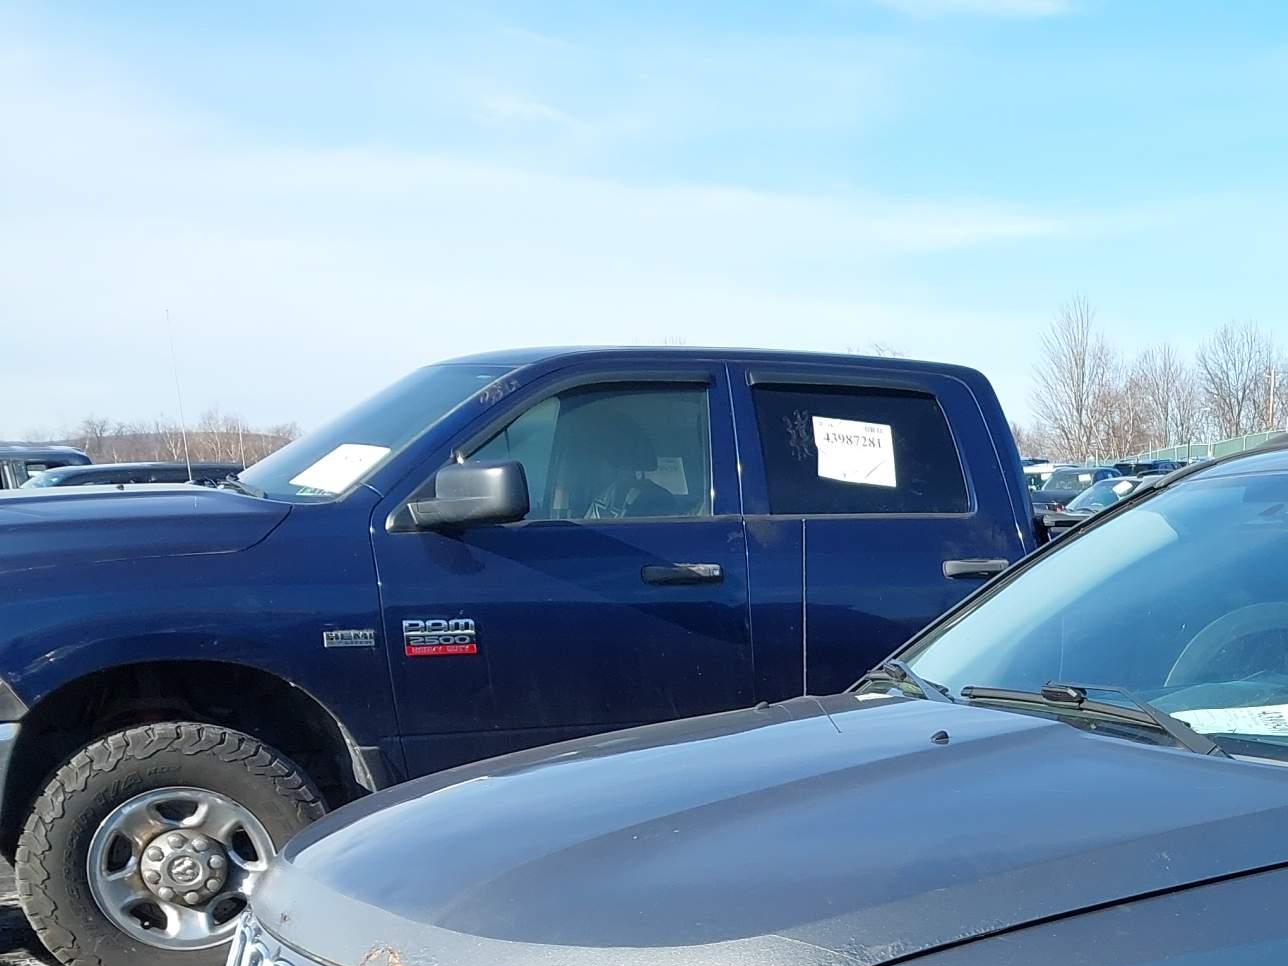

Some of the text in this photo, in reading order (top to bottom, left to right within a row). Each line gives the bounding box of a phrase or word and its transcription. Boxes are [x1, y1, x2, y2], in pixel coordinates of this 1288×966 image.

[823, 432, 882, 449] 43987281
[403, 618, 476, 633] RAM
[409, 635, 471, 646] 2500
